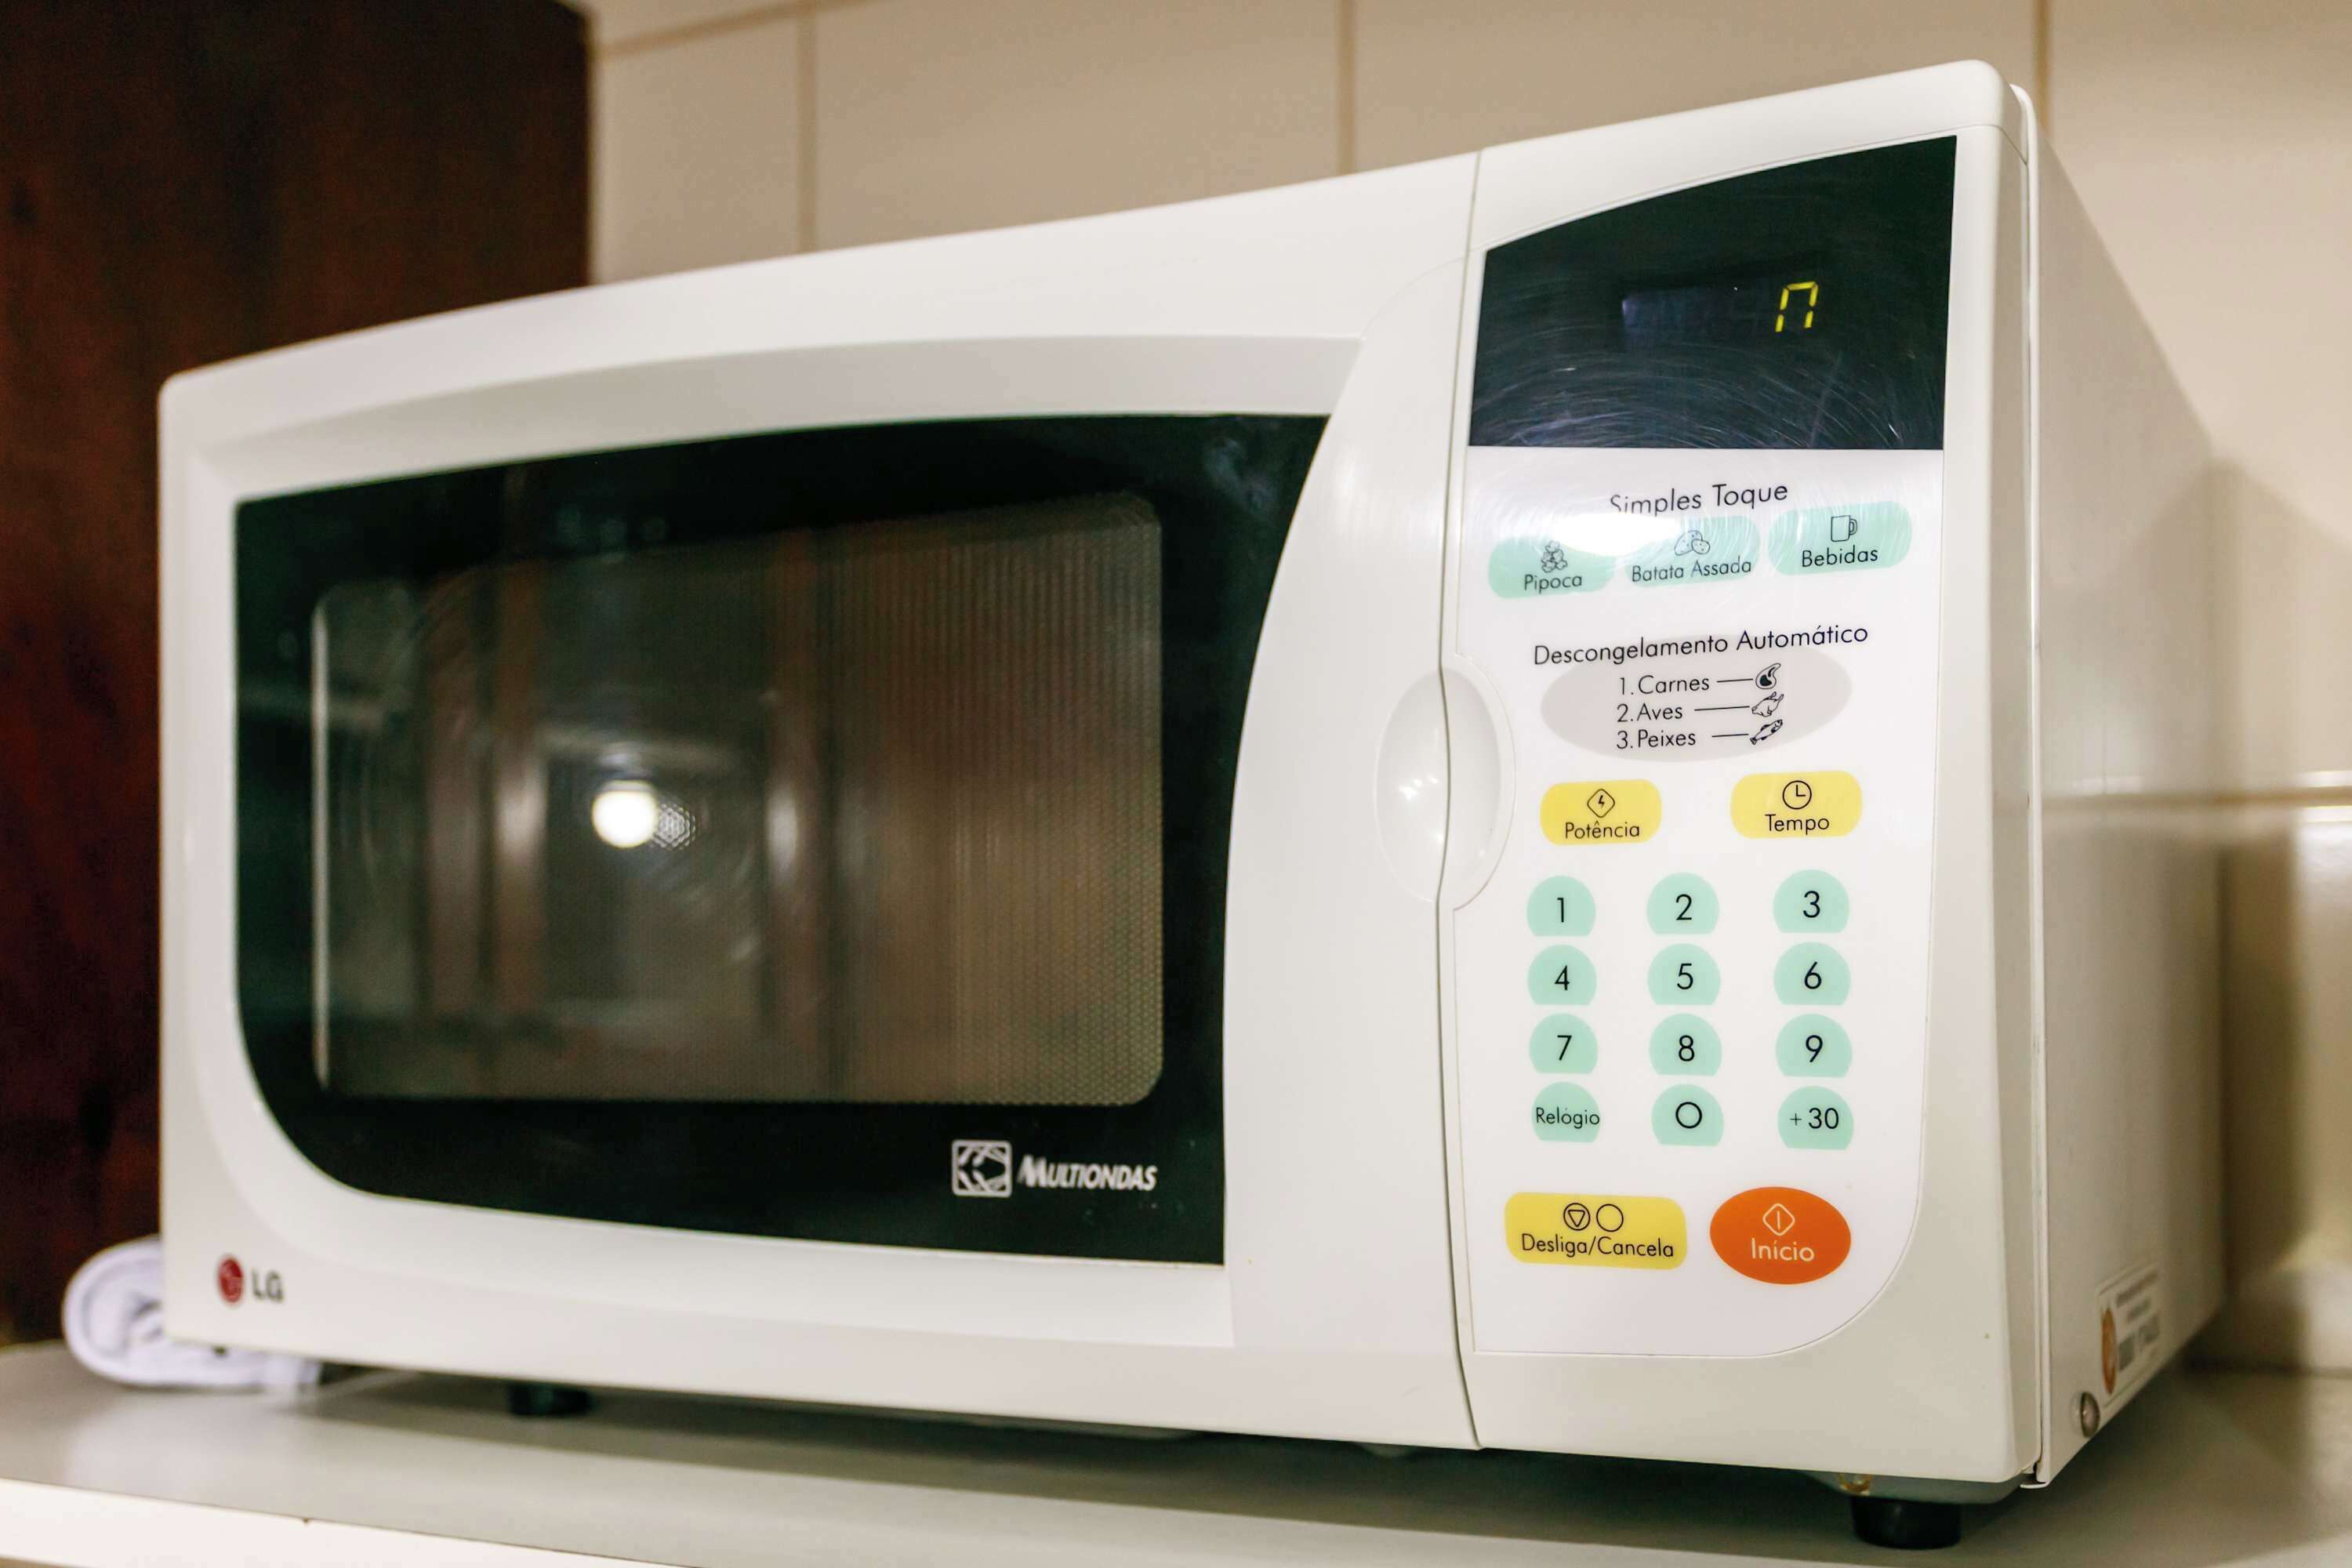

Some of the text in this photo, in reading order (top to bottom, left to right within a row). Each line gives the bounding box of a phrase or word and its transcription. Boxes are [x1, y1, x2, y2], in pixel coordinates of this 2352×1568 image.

[1610, 481, 1788, 517] Simples Toque
[1632, 557, 1751, 583] Batata Assada
[1802, 547, 1878, 568] Bebidas
[1524, 572, 1582, 593] Pipoca
[1534, 625, 1868, 665] Descongelamento Automático
[1565, 821, 1639, 839] Potência
[1765, 814, 1830, 836] Tempo
[1556, 897, 1566, 923] 1
[1675, 894, 1693, 920] 2
[1803, 891, 1820, 918] 3
[1555, 965, 1570, 990] 4
[1677, 963, 1693, 989] 5
[1804, 961, 1822, 989] 6
[1557, 1035, 1572, 1061] 7
[1678, 1035, 1695, 1062] 8
[1805, 1034, 1823, 1062] 9
[1536, 1106, 1600, 1129] Relógio
[1521, 1233, 1674, 1258] Desliga/Cancela
[1751, 1239, 1815, 1262] Início
[252, 1269, 284, 1303] LG
